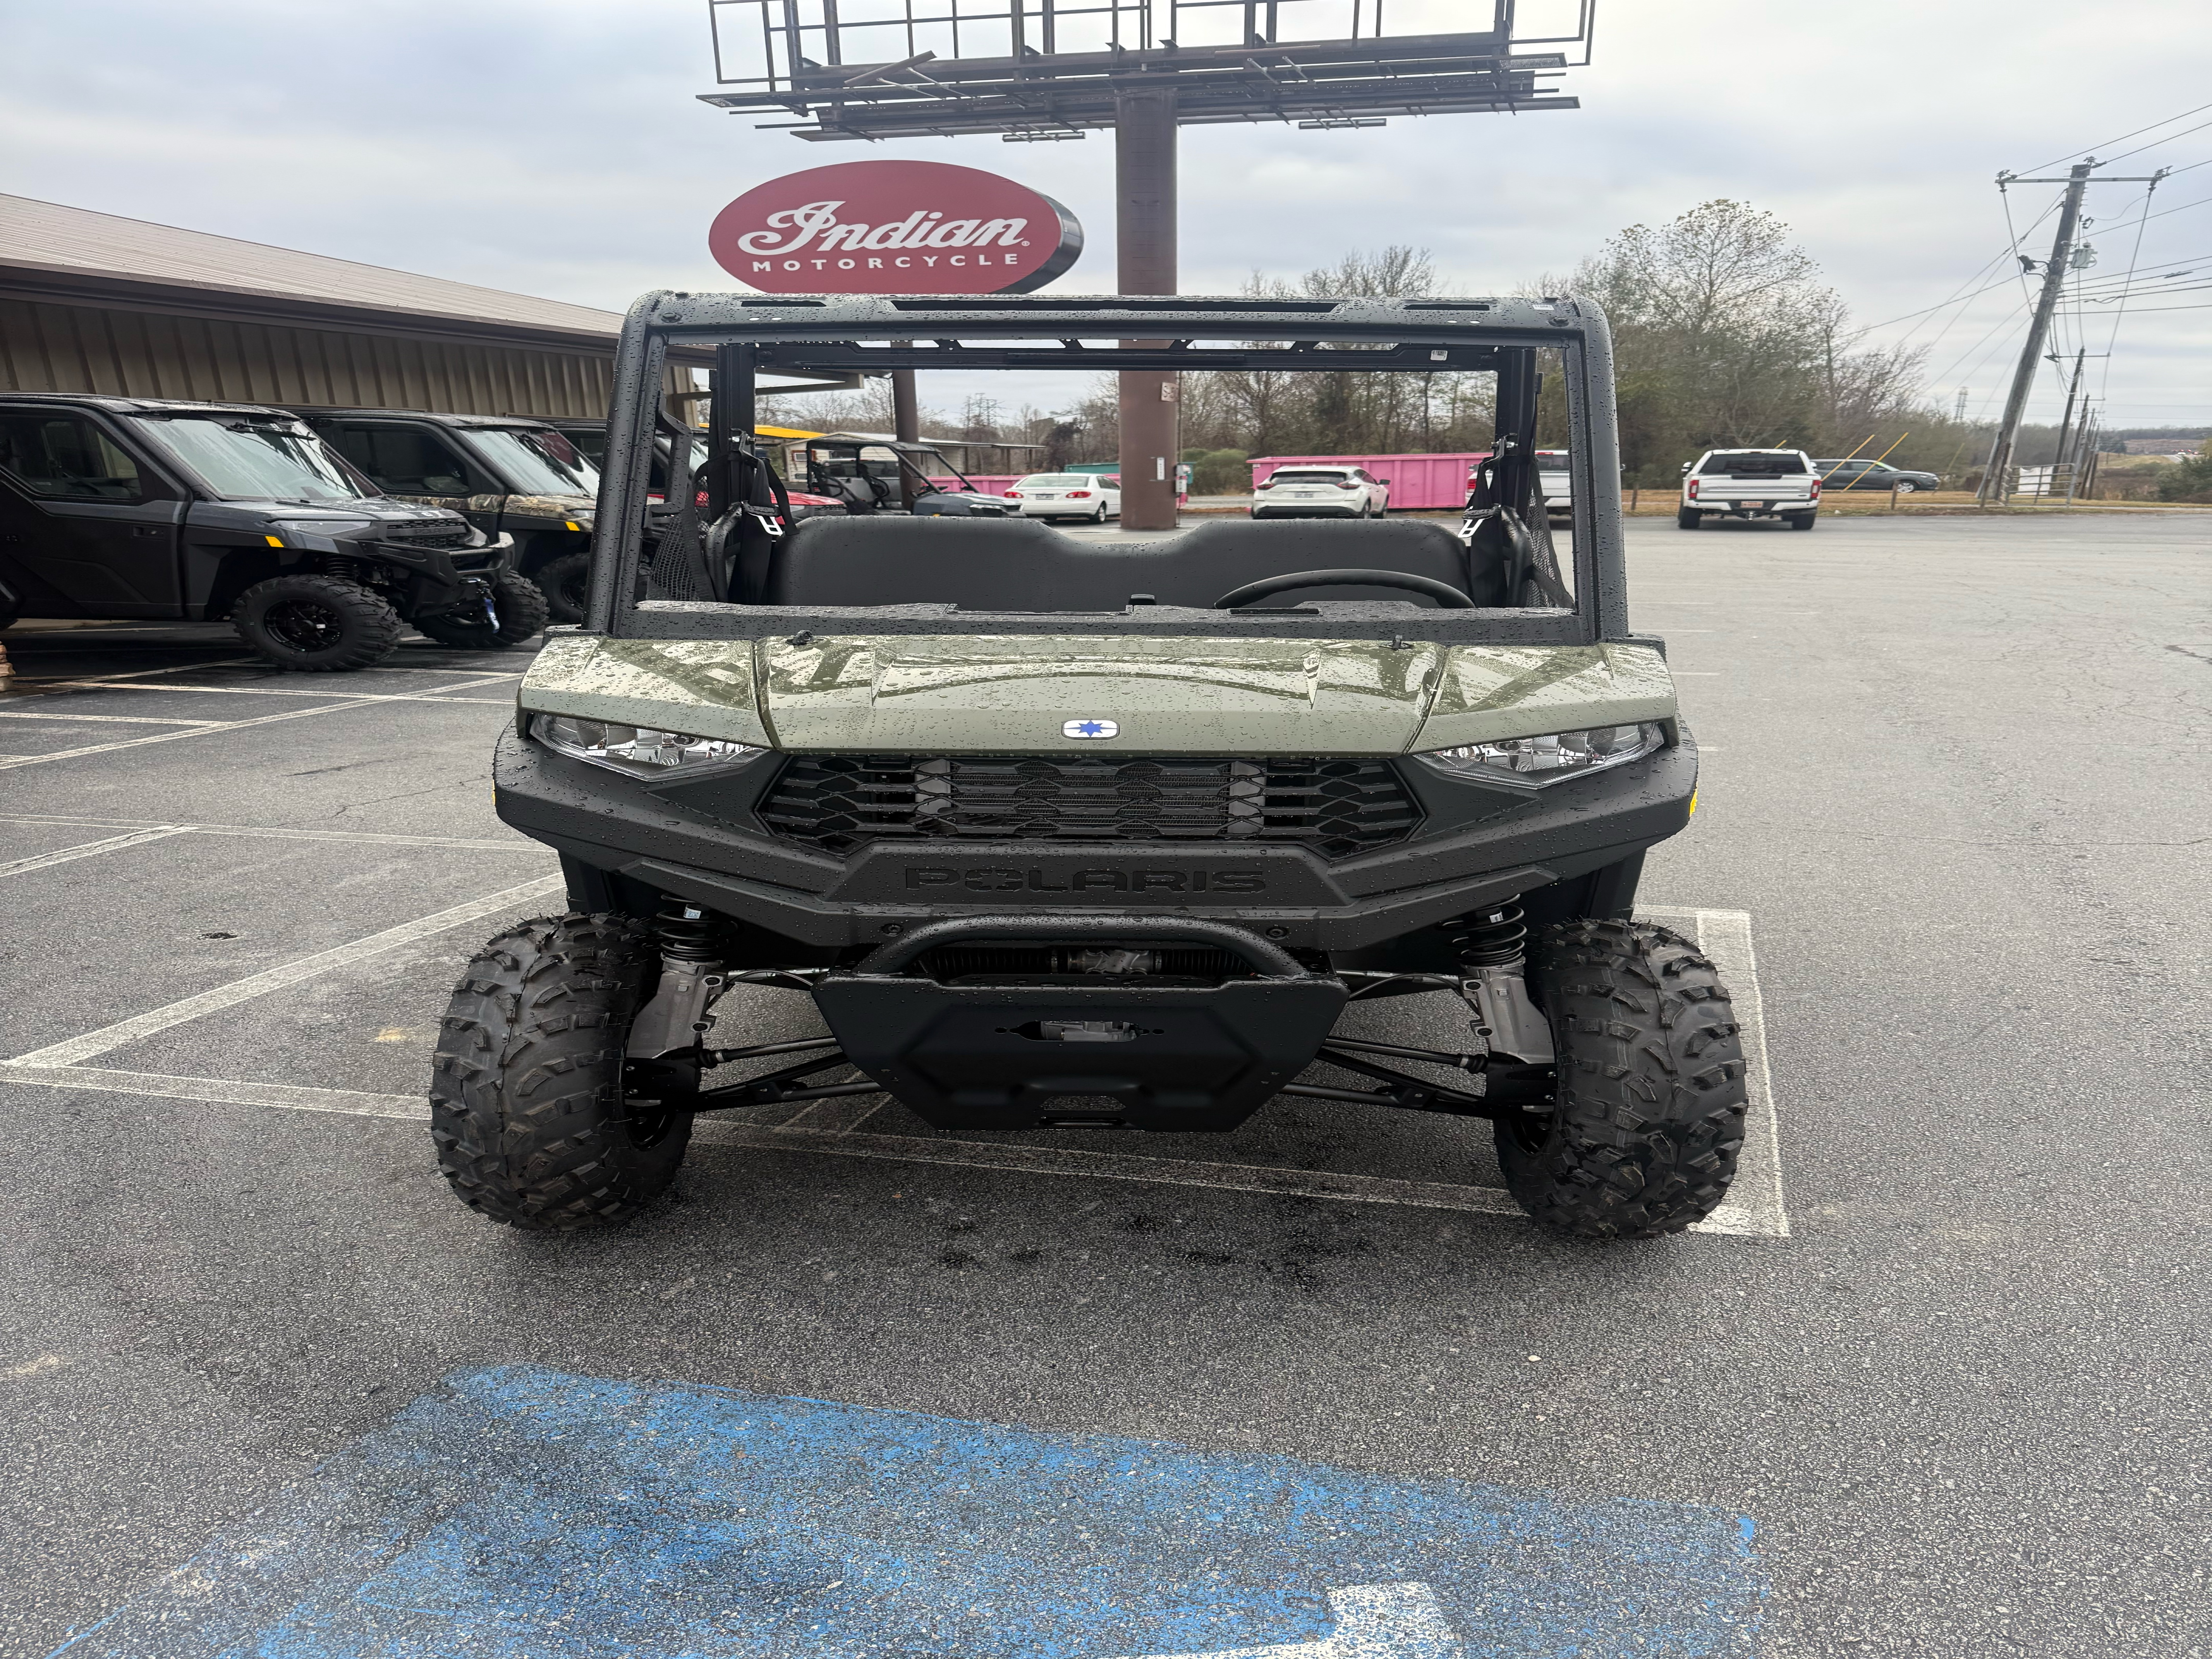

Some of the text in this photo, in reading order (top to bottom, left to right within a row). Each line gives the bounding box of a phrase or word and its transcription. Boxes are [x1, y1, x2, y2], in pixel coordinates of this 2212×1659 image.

[738, 201, 1028, 256] Indian
[753, 254, 1018, 272] MOTORCYCLE
[906, 868, 1266, 894] POLARIS
